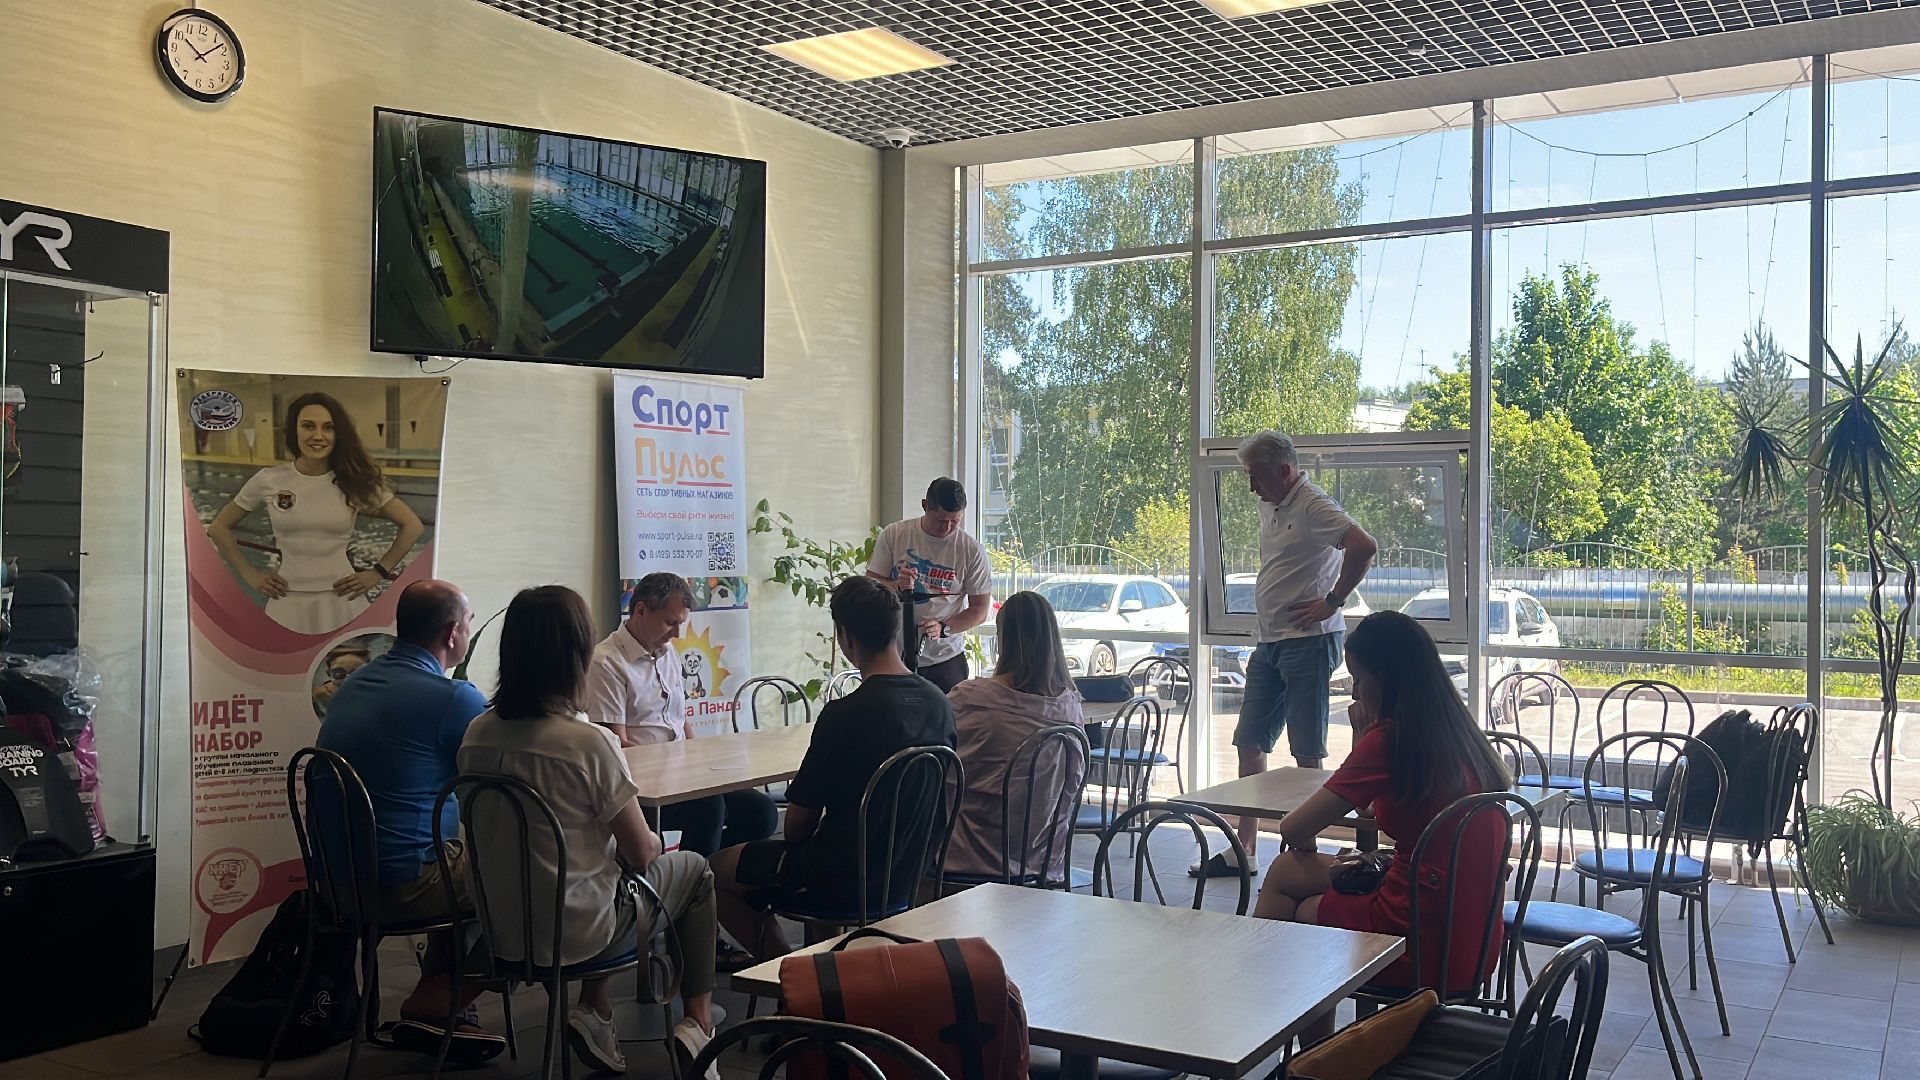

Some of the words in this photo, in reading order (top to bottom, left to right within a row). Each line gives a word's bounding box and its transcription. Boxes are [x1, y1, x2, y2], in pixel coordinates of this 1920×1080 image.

[187, 23, 194, 35] 11
[199, 24, 208, 37] 12
[174, 29, 184, 41] 10
[213, 32, 218, 43] 1
[171, 42, 178, 52] 9
[221, 45, 228, 57] 2
[174, 58, 180, 67] 8
[223, 59, 230, 71] 3
[183, 69, 189, 80] 7
[218, 72, 225, 83] 4
[195, 78, 202, 89] 6
[208, 78, 215, 89] 5
[0, 211, 73, 270] YR
[632, 385, 730, 435] Спорт
[635, 438, 726, 484] Пульс
[637, 488, 652, 497] СЕТЬ
[655, 489, 695, 499] СПОРТИВНЫХ
[697, 491, 734, 500] МАГАЗИНОВ
[638, 510, 667, 519] Выбери
[639, 533, 703, 542] www.sport-pulse.ru
[650, 550, 654, 558] 8
[673, 550, 703, 559] 532-70-07
[929, 567, 956, 580] BIKE
[930, 578, 953, 588] VOLGA
[194, 693, 264, 730] ИДЁТ
[194, 731, 262, 753] НАБОР
[0, 750, 44, 760] RAINING
[200, 754, 228, 762] группы
[9, 765, 39, 777] TYR
[194, 769, 213, 778] детей
